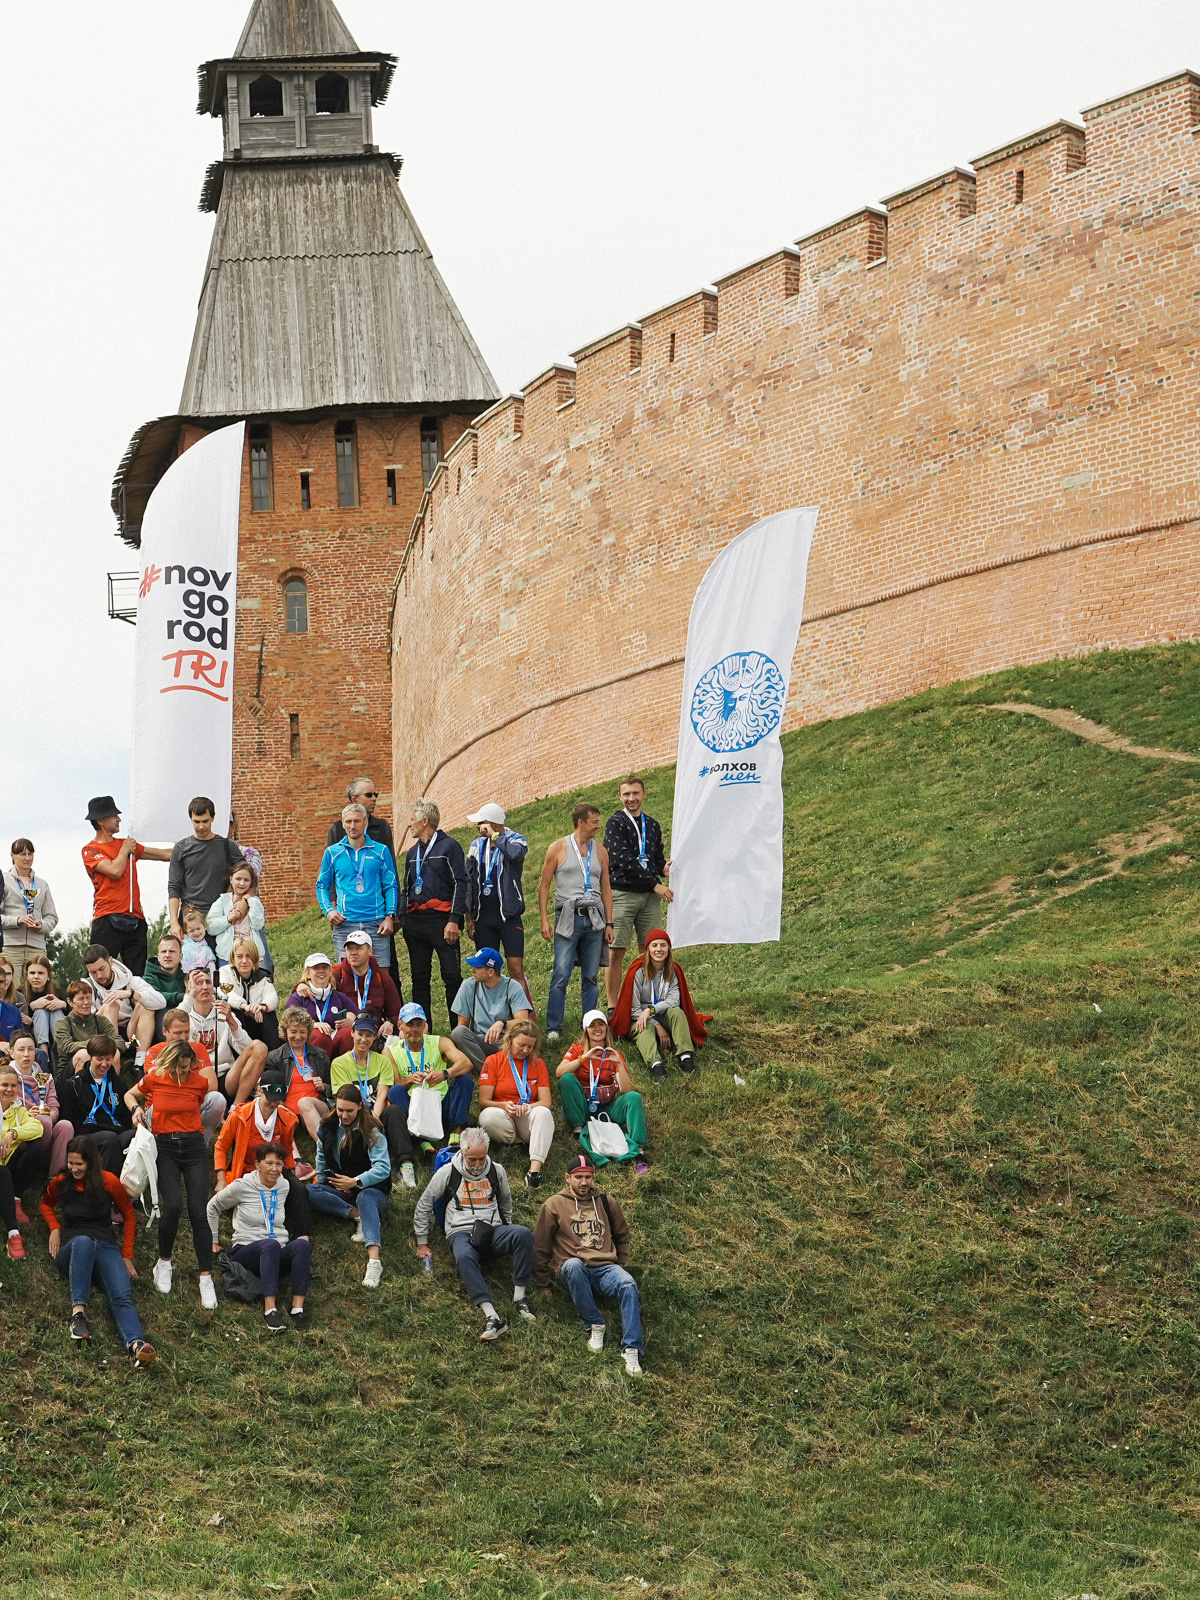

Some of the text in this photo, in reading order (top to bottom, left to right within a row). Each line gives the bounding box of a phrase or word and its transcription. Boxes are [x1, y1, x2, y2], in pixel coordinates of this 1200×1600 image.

[139, 564, 232, 598] #nov
[183, 589, 229, 619] go
[167, 617, 228, 650] rod
[161, 650, 228, 688] TRI
